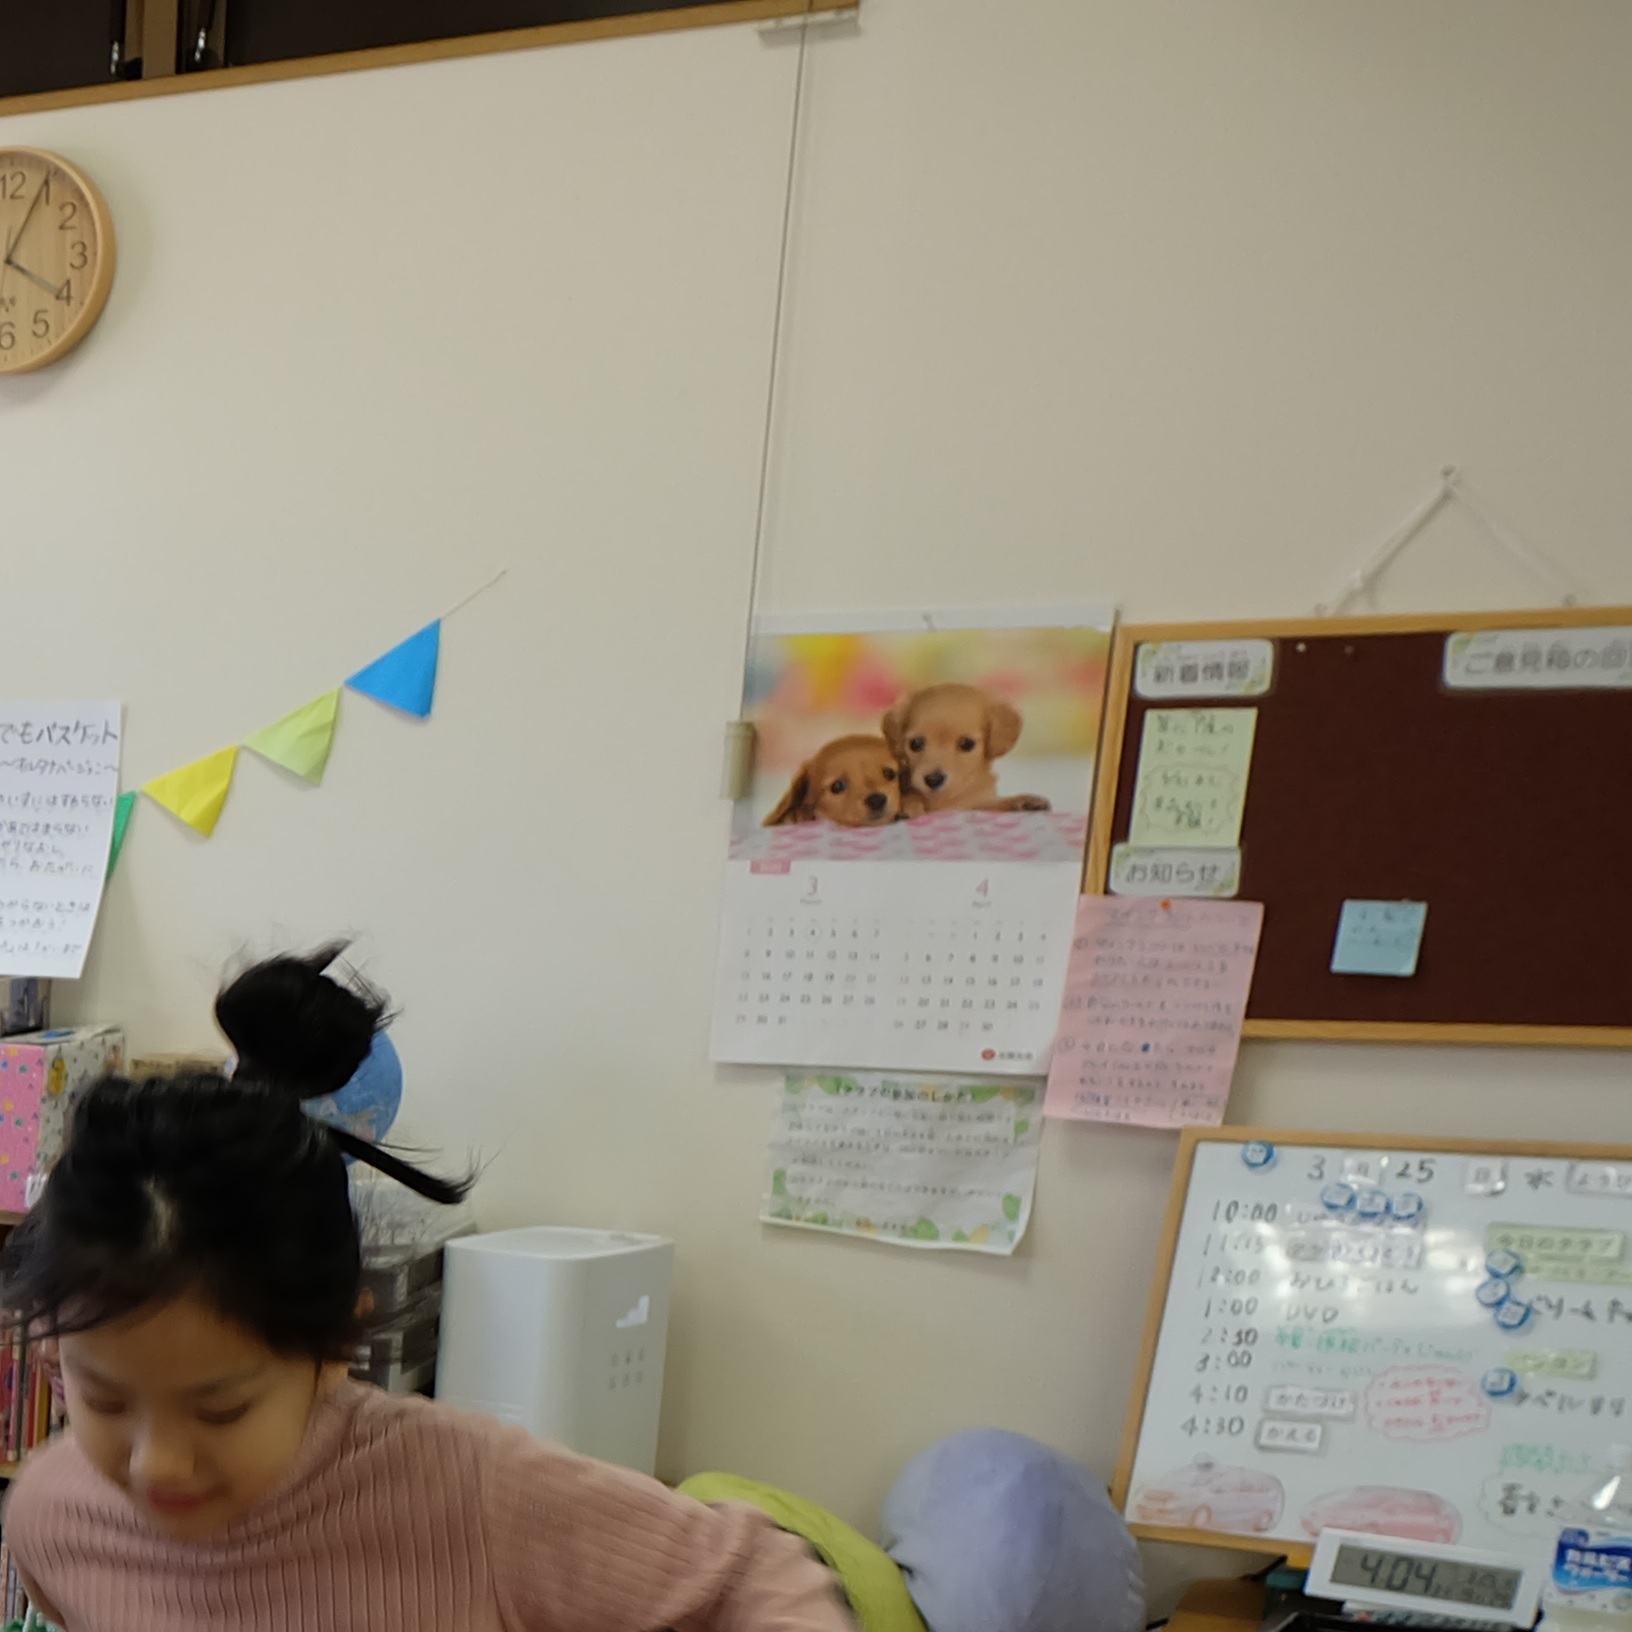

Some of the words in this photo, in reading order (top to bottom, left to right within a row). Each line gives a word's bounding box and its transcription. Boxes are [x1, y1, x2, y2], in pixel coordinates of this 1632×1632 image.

[0, 171, 26, 200] 12
[58, 202, 77, 231] 2
[69, 241, 87, 270] 3
[55, 278, 72, 306] 4
[32, 309, 50, 338] 5
[1464, 639, 1632, 675] ご意見箱の回
[1126, 862, 1218, 884] お知らせ
[807, 876, 818, 896] 3
[975, 878, 989, 896] 4
[1307, 1154, 1326, 1181] 3
[1396, 1157, 1435, 1183] 25
[1212, 1199, 1278, 1222] 10:00
[1204, 1296, 1258, 1318] 1:00
[1195, 1349, 1253, 1372] 3:00
[1189, 1383, 1248, 1404] 4:10
[1180, 1415, 1246, 1438] 4:30
